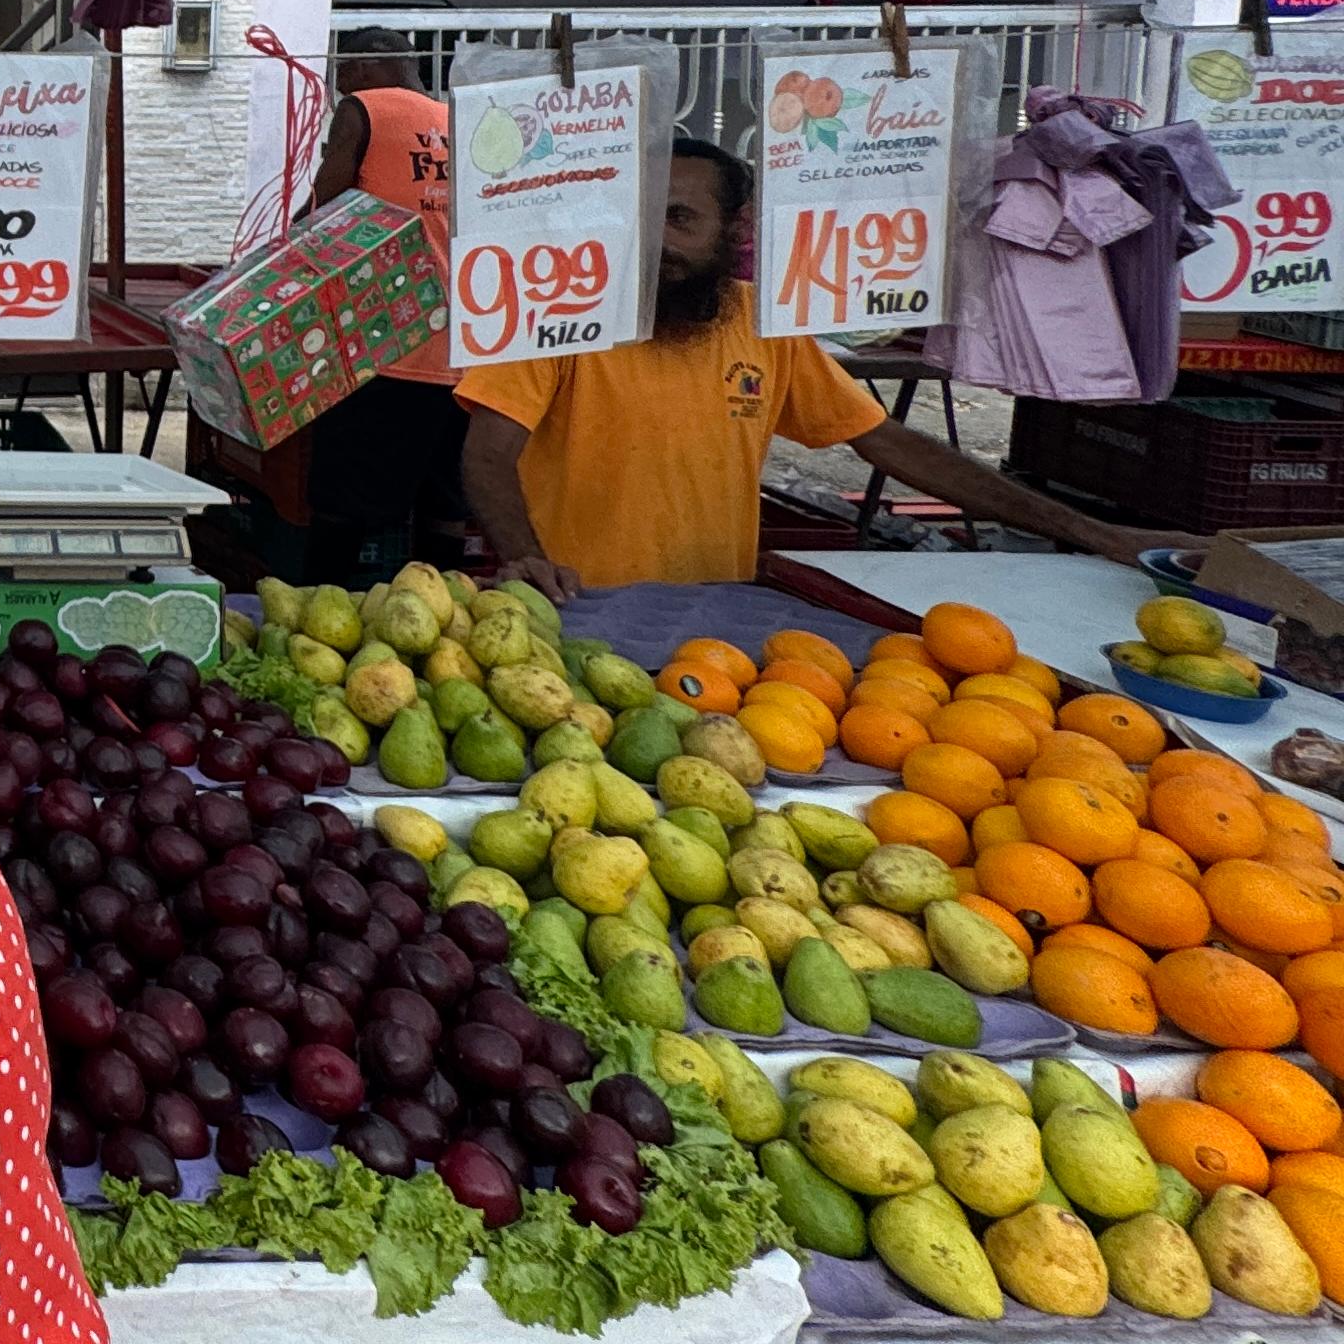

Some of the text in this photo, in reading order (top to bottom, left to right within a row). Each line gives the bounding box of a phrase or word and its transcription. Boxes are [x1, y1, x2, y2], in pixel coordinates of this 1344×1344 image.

[862, 68, 931, 83] LARAAS
[535, 80, 633, 118] GOIABA
[551, 115, 625, 136] VERMELHA
[545, 142, 632, 168] SUPER DOCE
[768, 140, 802, 156] BEM
[853, 136, 939, 153] IMPORTADA
[768, 156, 803, 170] DOCE
[799, 162, 924, 183] SELECIONADAS
[483, 192, 564, 212] DELICIOSA
[777, 207, 928, 327] 14,99
[1251, 256, 1331, 294] BACIA
[458, 239, 609, 357] 9,99
[866, 288, 929, 315] KILO
[537, 320, 601, 348] KILO
[1271, 463, 1328, 481] FRUTAS
